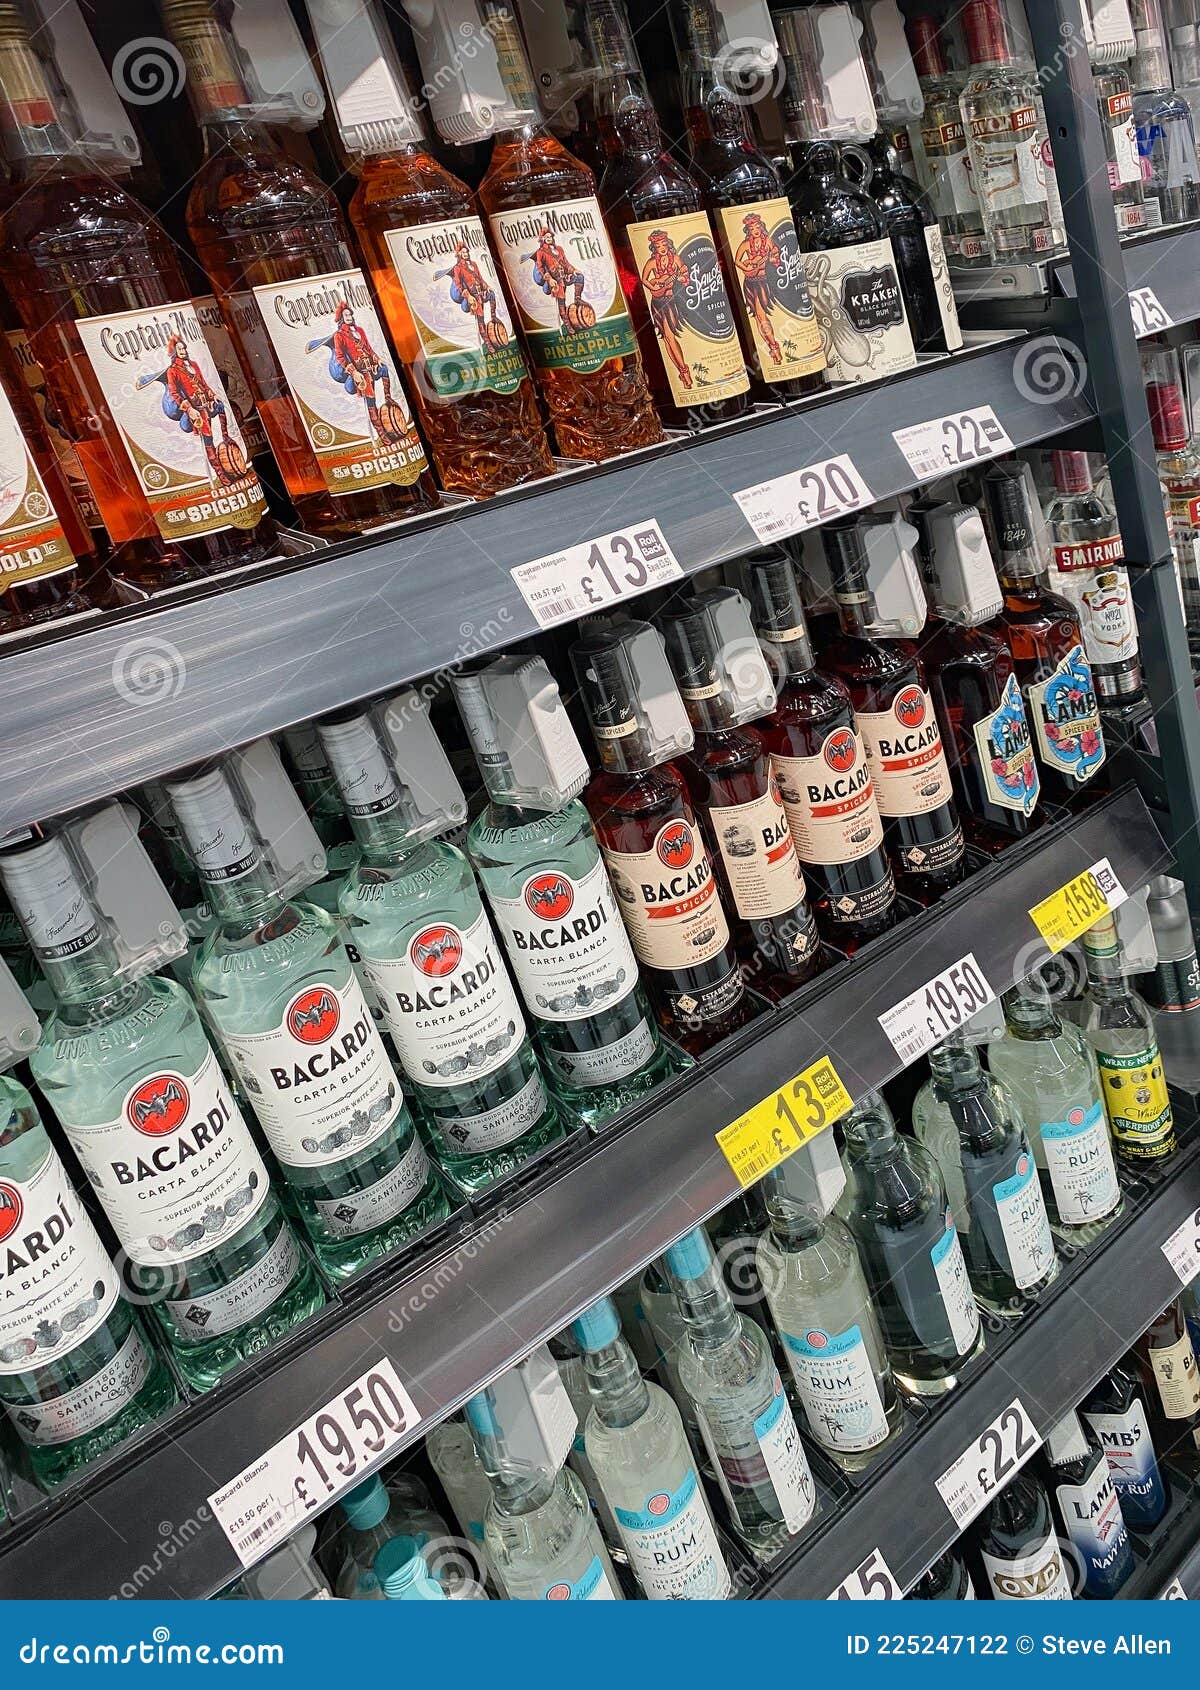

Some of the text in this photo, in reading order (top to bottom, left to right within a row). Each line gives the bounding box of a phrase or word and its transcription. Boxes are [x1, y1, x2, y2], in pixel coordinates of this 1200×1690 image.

[499, 208, 595, 247] Captain Morgan
[406, 229, 460, 265] Captain
[569, 235, 604, 261] Tiki
[274, 283, 339, 328] Captain
[851, 286, 898, 307] KRAKEN
[860, 304, 881, 313] BLACK
[875, 309, 890, 318] RUM
[101, 315, 173, 364] Captain
[544, 333, 622, 360] PINEAPPLE
[558, 333, 590, 344] MANGO
[372, 437, 414, 457] ORIGINAL
[942, 415, 993, 465] £22
[351, 451, 408, 479] SPICED
[211, 478, 254, 498] ORIGINAL
[797, 463, 861, 525] £20
[187, 490, 248, 522] SPICED
[639, 533, 657, 547] Roll
[641, 543, 663, 556] Back
[1003, 529, 1026, 542] 1849
[0, 546, 44, 574] OLD
[581, 535, 649, 604] £13
[1100, 620, 1127, 632] VODKA
[878, 720, 940, 758] BACARD
[1064, 721, 1098, 736] SPICED RUM
[906, 749, 937, 768] SPICED
[807, 762, 869, 804] BACARD
[837, 791, 869, 814] SPICED
[210, 868, 228, 880] RUM
[641, 856, 712, 903] BACARD
[674, 888, 711, 914] SPICED
[512, 895, 608, 951] BACARDÍ
[55, 938, 84, 957] WHITE
[529, 936, 608, 965] CARTA BLANCA
[396, 945, 496, 1013] BACARDÍ
[546, 978, 576, 988] SUPERIOR
[577, 970, 596, 982] WHITE
[415, 987, 498, 1029] CARTA BLANCA
[925, 961, 989, 1040] £19.50
[270, 1003, 373, 1090] BACARDÍ
[435, 1035, 468, 1051] SUPERIOR
[467, 1025, 488, 1042] WHITE
[586, 1049, 629, 1069] SANTIAGO
[1103, 1057, 1136, 1067] WRAY &
[294, 1048, 376, 1104] CARTA BLANCA
[816, 1070, 831, 1085] Roll
[819, 1080, 837, 1096] Back
[316, 1105, 351, 1126] SUPERIOR
[350, 1091, 372, 1109] WHITE
[482, 1104, 525, 1132] SANTIAGO
[771, 1079, 826, 1156] £13
[110, 1089, 232, 1186] BACARDÍ
[137, 1137, 235, 1201] CARTA BLANCA
[1068, 1147, 1100, 1168] RUM
[163, 1172, 239, 1222] SUPERIOR WHITE RUM
[370, 1169, 412, 1206] SANTIAGO
[0, 1192, 74, 1281] ARDÍ
[21, 1245, 77, 1291] BLANCA
[34, 1283, 80, 1318] WHITE RUM
[226, 1265, 276, 1307] SANTIAGO
[795, 1361, 857, 1376] WHITE
[800, 1357, 849, 1367] SUPERIOR
[56, 1376, 118, 1419] SANTIAGO
[810, 1375, 853, 1391] RUM
[294, 1373, 407, 1510] £19.50
[977, 1407, 1037, 1495] £22
[214, 1460, 270, 1507] Bacardi Blanca
[1127, 1477, 1154, 1496] RUM
[229, 1499, 271, 1535] £19.50 per
[641, 1511, 693, 1540] SUPERIOR
[635, 1515, 700, 1550] WHITE
[653, 1533, 697, 1565] RUM
[1091, 1542, 1119, 1570] NAVY
[1001, 1561, 1057, 1596] OVD
